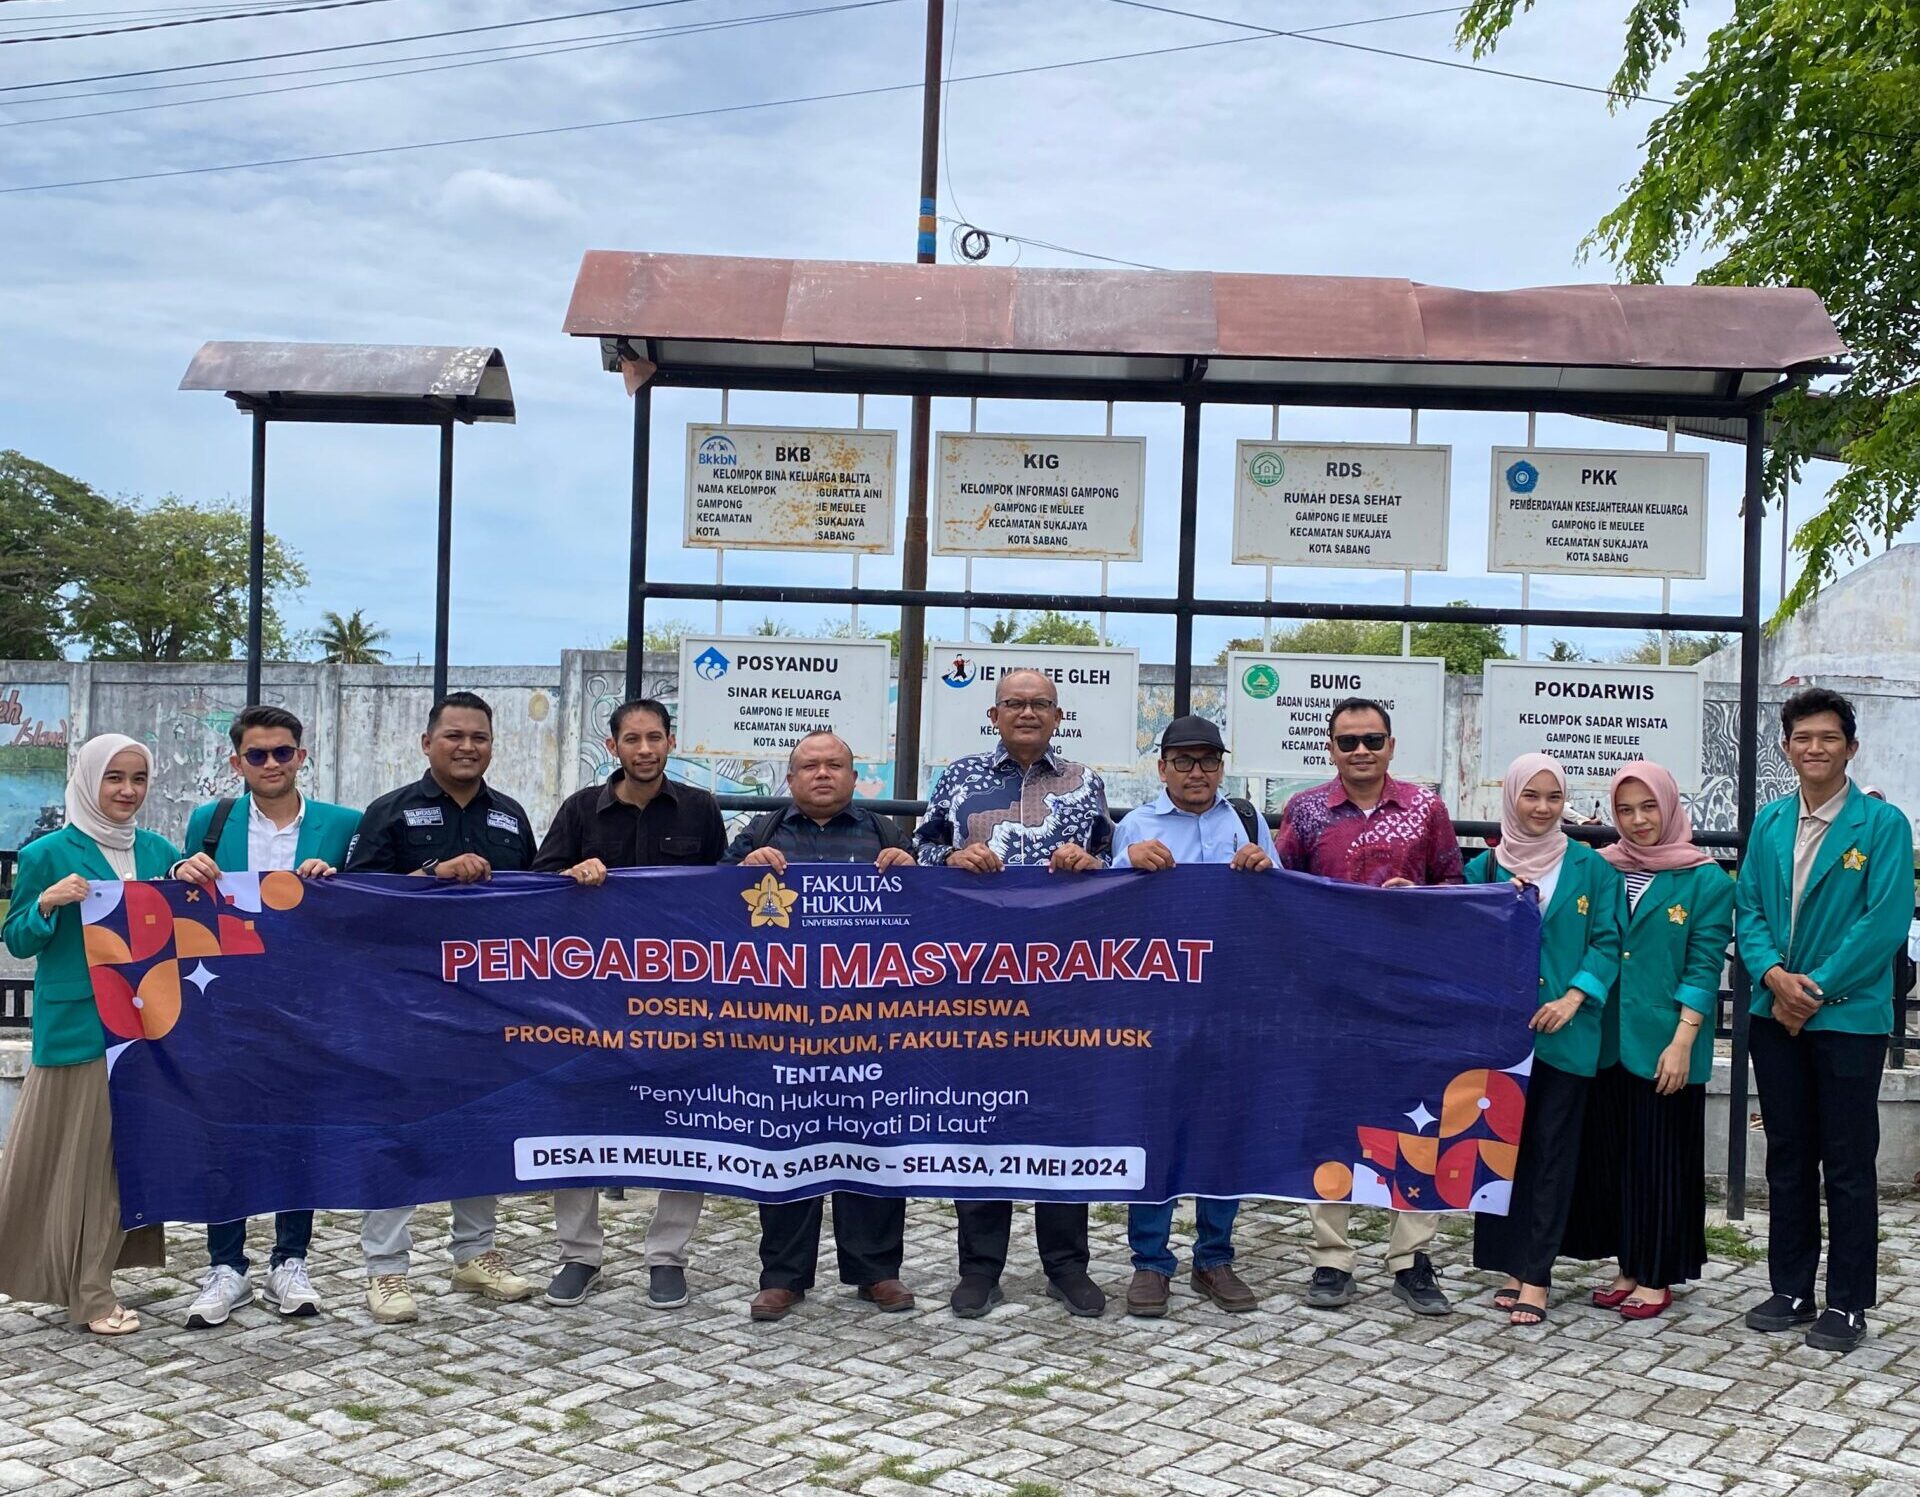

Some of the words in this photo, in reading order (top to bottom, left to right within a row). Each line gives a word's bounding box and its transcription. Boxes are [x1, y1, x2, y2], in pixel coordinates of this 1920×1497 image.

[775, 446, 811, 462] BKB
[1024, 454, 1060, 469] KIG
[713, 468, 762, 481] KELOMPOK
[765, 470, 787, 481] BINA
[789, 471, 837, 483] KELUARGA
[839, 472, 871, 484] BALITA
[1326, 462, 1362, 478] RDS
[1581, 469, 1618, 486] PKK
[697, 484, 724, 494] NAMA
[726, 485, 777, 495] KELOMPOK
[863, 489, 882, 499] AINI
[960, 483, 1013, 495] KELOMPOK
[1016, 485, 1068, 497] INFORMASI
[1071, 487, 1119, 499] GAMPONG
[697, 498, 743, 509] GAMPONG
[829, 503, 866, 513] MEULEE
[1284, 492, 1326, 504] RUMAH
[1329, 494, 1360, 505] DESA
[1364, 495, 1402, 506] SEHAT
[994, 502, 1037, 513] GAMPONG
[1040, 504, 1048, 513] IE
[1050, 504, 1085, 515] MEULEE
[1510, 499, 1573, 512] PEMBERDAYAAN
[1575, 501, 1643, 514] KESEJAHTERAAN
[1645, 503, 1688, 516] KELUARGA
[696, 512, 752, 523] KECAMATAN
[1295, 511, 1339, 523] GAMPONG
[1342, 513, 1350, 522] IE
[1352, 513, 1388, 523] MEULEE
[695, 527, 721, 537] KOTA
[988, 519, 1041, 530] KECAMATAN
[1043, 520, 1088, 531] SUKAJAYA
[1552, 519, 1596, 530] GAMPONG
[1598, 521, 1607, 530] IE
[1609, 521, 1645, 531] MEULEE
[1289, 527, 1343, 538] KECAMATAN
[1345, 529, 1392, 539] SUKAJAYA
[1007, 535, 1030, 545] KOTA
[1032, 535, 1068, 546] SABANG
[1546, 536, 1600, 548] KECAMATAN
[1602, 538, 1649, 549] SUKAJAYA
[1308, 544, 1332, 554] KOTA
[1334, 544, 1371, 555] SABANG
[1566, 552, 1590, 562] KOTA
[1592, 552, 1629, 563] SABANG
[737, 655, 838, 673] POSYANDU
[980, 666, 995, 681] IE
[1068, 669, 1110, 685] GLEH
[1310, 674, 1361, 690] BUMG
[727, 687, 767, 698] SINAR
[771, 688, 842, 701] KELUARGA
[1535, 681, 1655, 700] POKDARWIS
[1276, 696, 1302, 708] BADAN
[1304, 697, 1331, 709] USAHA
[739, 706, 782, 716] GAMPONG
[785, 707, 793, 716] IE
[795, 708, 830, 718] MEULEE
[1290, 712, 1327, 723] KUCHI
[733, 722, 786, 732] KECAMATAN
[1519, 713, 1582, 726] KELOMPOK
[1585, 716, 1623, 728] SADAR
[1626, 717, 1668, 729] WISATA
[753, 737, 776, 747] KOTA
[778, 738, 801, 747] SABA
[1281, 740, 1329, 751] KECAMATA
[1546, 733, 1591, 744] GAMPONG
[1593, 734, 1602, 744] IE
[1604, 735, 1640, 746] MEULEE
[1303, 756, 1326, 766] KOTA
[1597, 750, 1644, 761] SUKAJAYA
[1587, 766, 1621, 777] SABAN
[801, 875, 903, 893] FAKULTAS
[802, 895, 882, 914] HUKUM
[801, 919, 853, 927] UNIVERSITAS
[854, 918, 880, 926] SYIAH
[881, 917, 910, 926] KUALA
[441, 936, 807, 989] PENGABDIAN
[820, 938, 1213, 989] MASYARAKAT
[628, 997, 714, 1021] DOSEN,
[719, 1000, 815, 1027] ALUMNI,
[820, 1001, 873, 1025] DAN
[877, 998, 1030, 1020] MAHASISWA
[504, 1025, 623, 1049] PROGRAM
[629, 1030, 697, 1050] STUDI
[702, 1031, 725, 1048] S1
[730, 1032, 784, 1052] ILMU
[790, 1031, 883, 1056] HUKUM,
[888, 1030, 1008, 1051] FAKULTAS
[1013, 1028, 1100, 1048] HUKUM
[1106, 1028, 1153, 1049] USK
[772, 1063, 883, 1085] TENTANG
[781, 1089, 864, 1112] Hukum
[872, 1086, 1029, 1112] Perlindungan
[664, 1109, 754, 1135] Sumber
[759, 1118, 820, 1143] Daya
[827, 1113, 902, 1140] Hayati
[909, 1113, 931, 1133] Di
[532, 1147, 594, 1167] DESA
[600, 1147, 618, 1164] IE
[623, 1147, 713, 1173] MEULEE,
[718, 1154, 779, 1180] KOTA
[783, 1152, 880, 1179] SABANG
[902, 1156, 994, 1177] SELASA,
[999, 1156, 1021, 1174] 21
[1027, 1157, 1066, 1177] MEI
[1071, 1158, 1128, 1177] 2024
